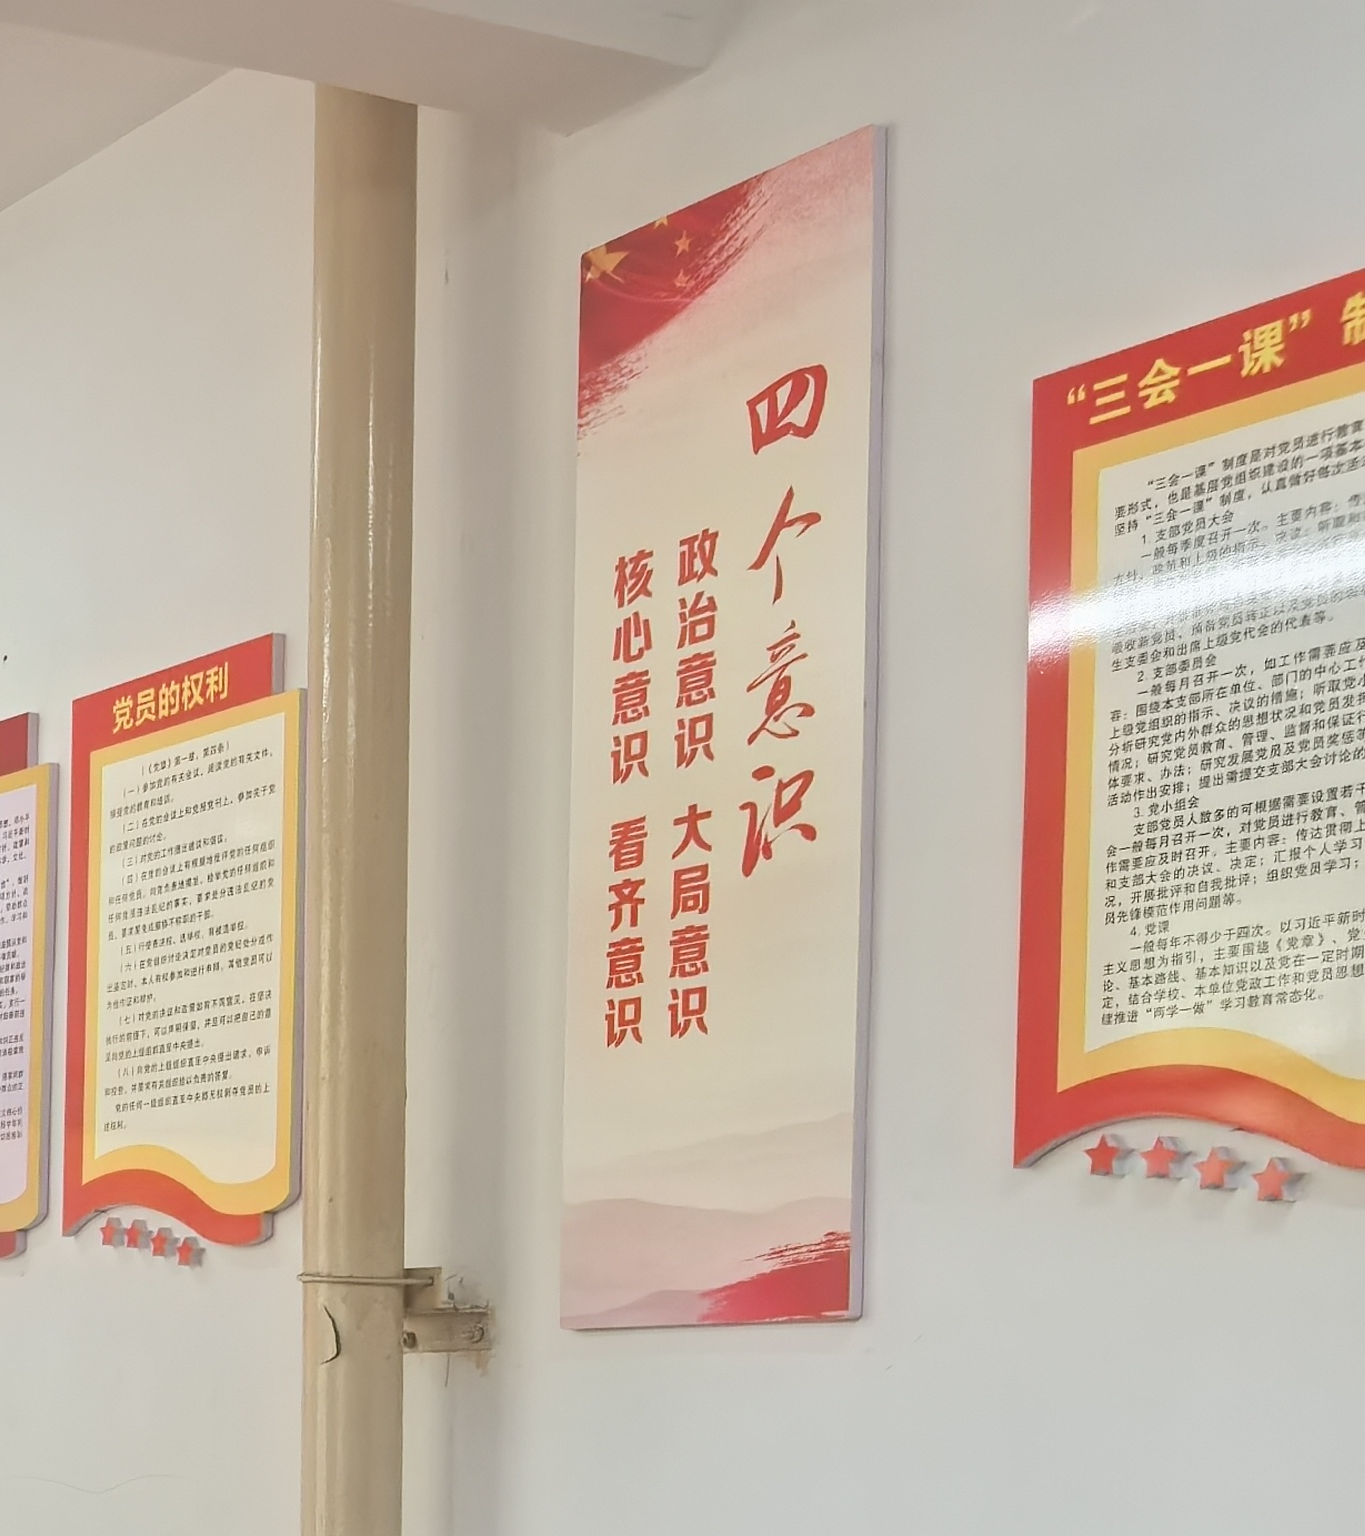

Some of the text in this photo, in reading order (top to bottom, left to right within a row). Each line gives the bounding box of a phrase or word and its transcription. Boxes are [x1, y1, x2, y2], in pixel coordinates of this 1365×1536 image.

[111, 661, 230, 735] 党员的权利
[610, 547, 655, 787] 核心意识
[674, 528, 720, 770] 政治意识
[737, 363, 828, 878] 四个意识
[603, 814, 648, 1049] 看齐意识
[668, 802, 712, 1041] 大局意识
